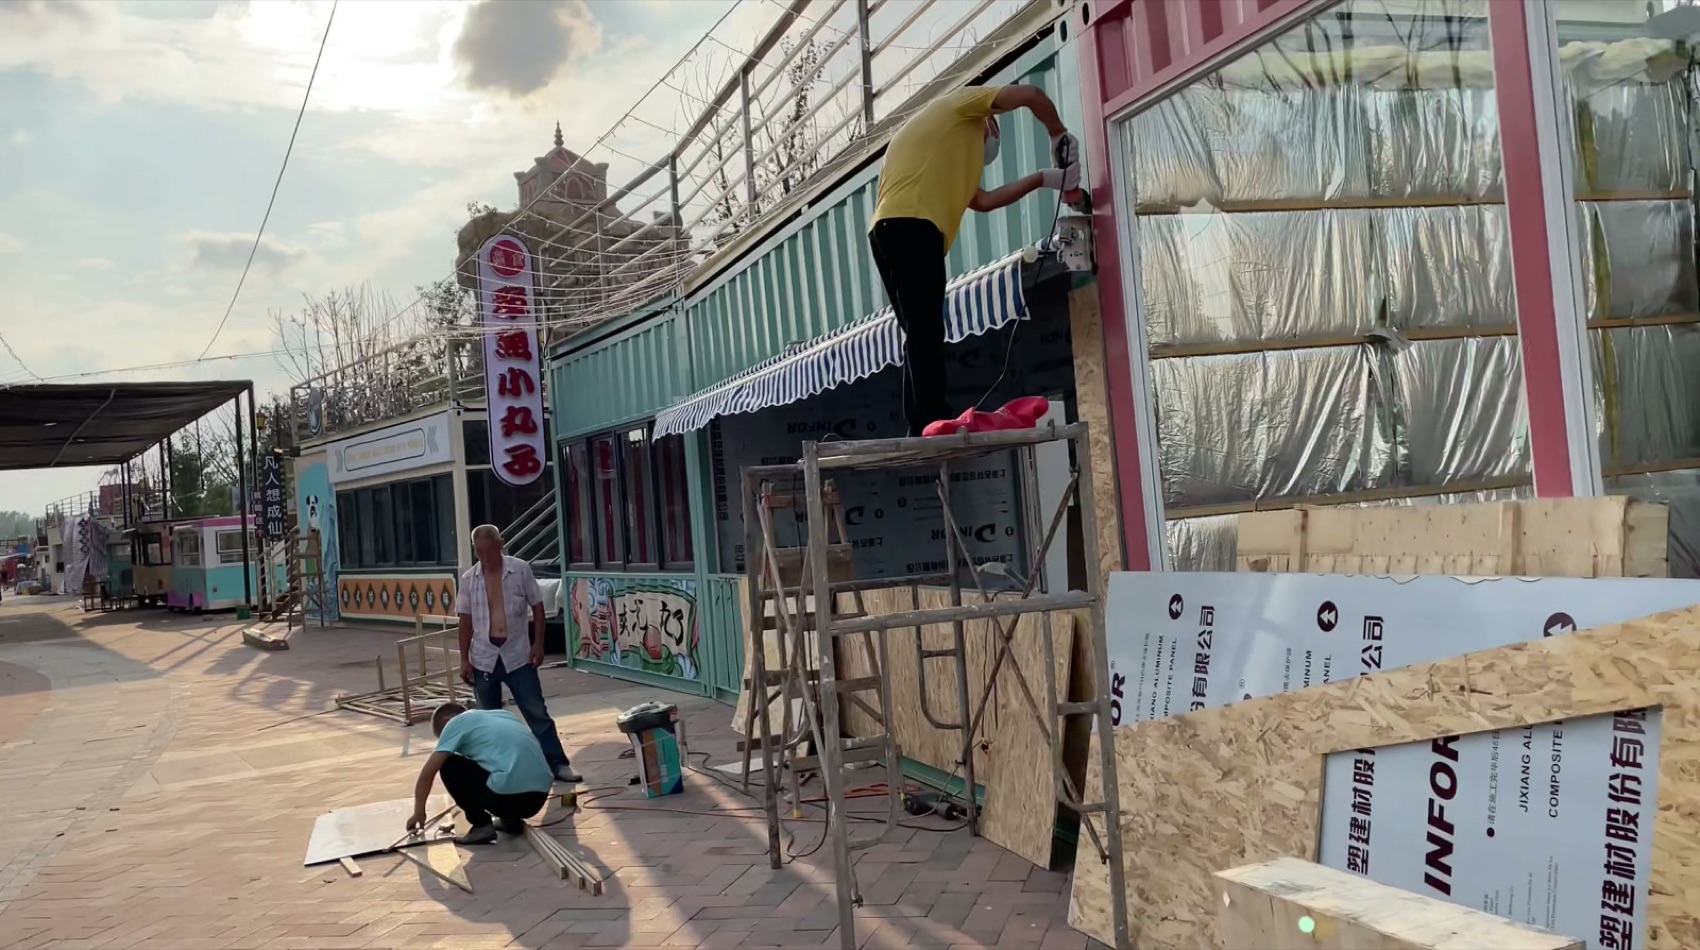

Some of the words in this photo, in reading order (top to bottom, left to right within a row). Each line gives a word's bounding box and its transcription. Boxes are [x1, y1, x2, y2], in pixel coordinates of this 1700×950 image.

[787, 420, 832, 434] INFOR
[263, 455, 283, 535] 凡人想成仙
[1154, 635, 1164, 689] ALUMINUM
[1169, 638, 1178, 673] PANEL
[1360, 615, 1385, 676] 公司
[1519, 754, 1531, 813] JIXIANG
[1548, 730, 1563, 818] COMPOSITE
[1424, 735, 1459, 896] INFOR
